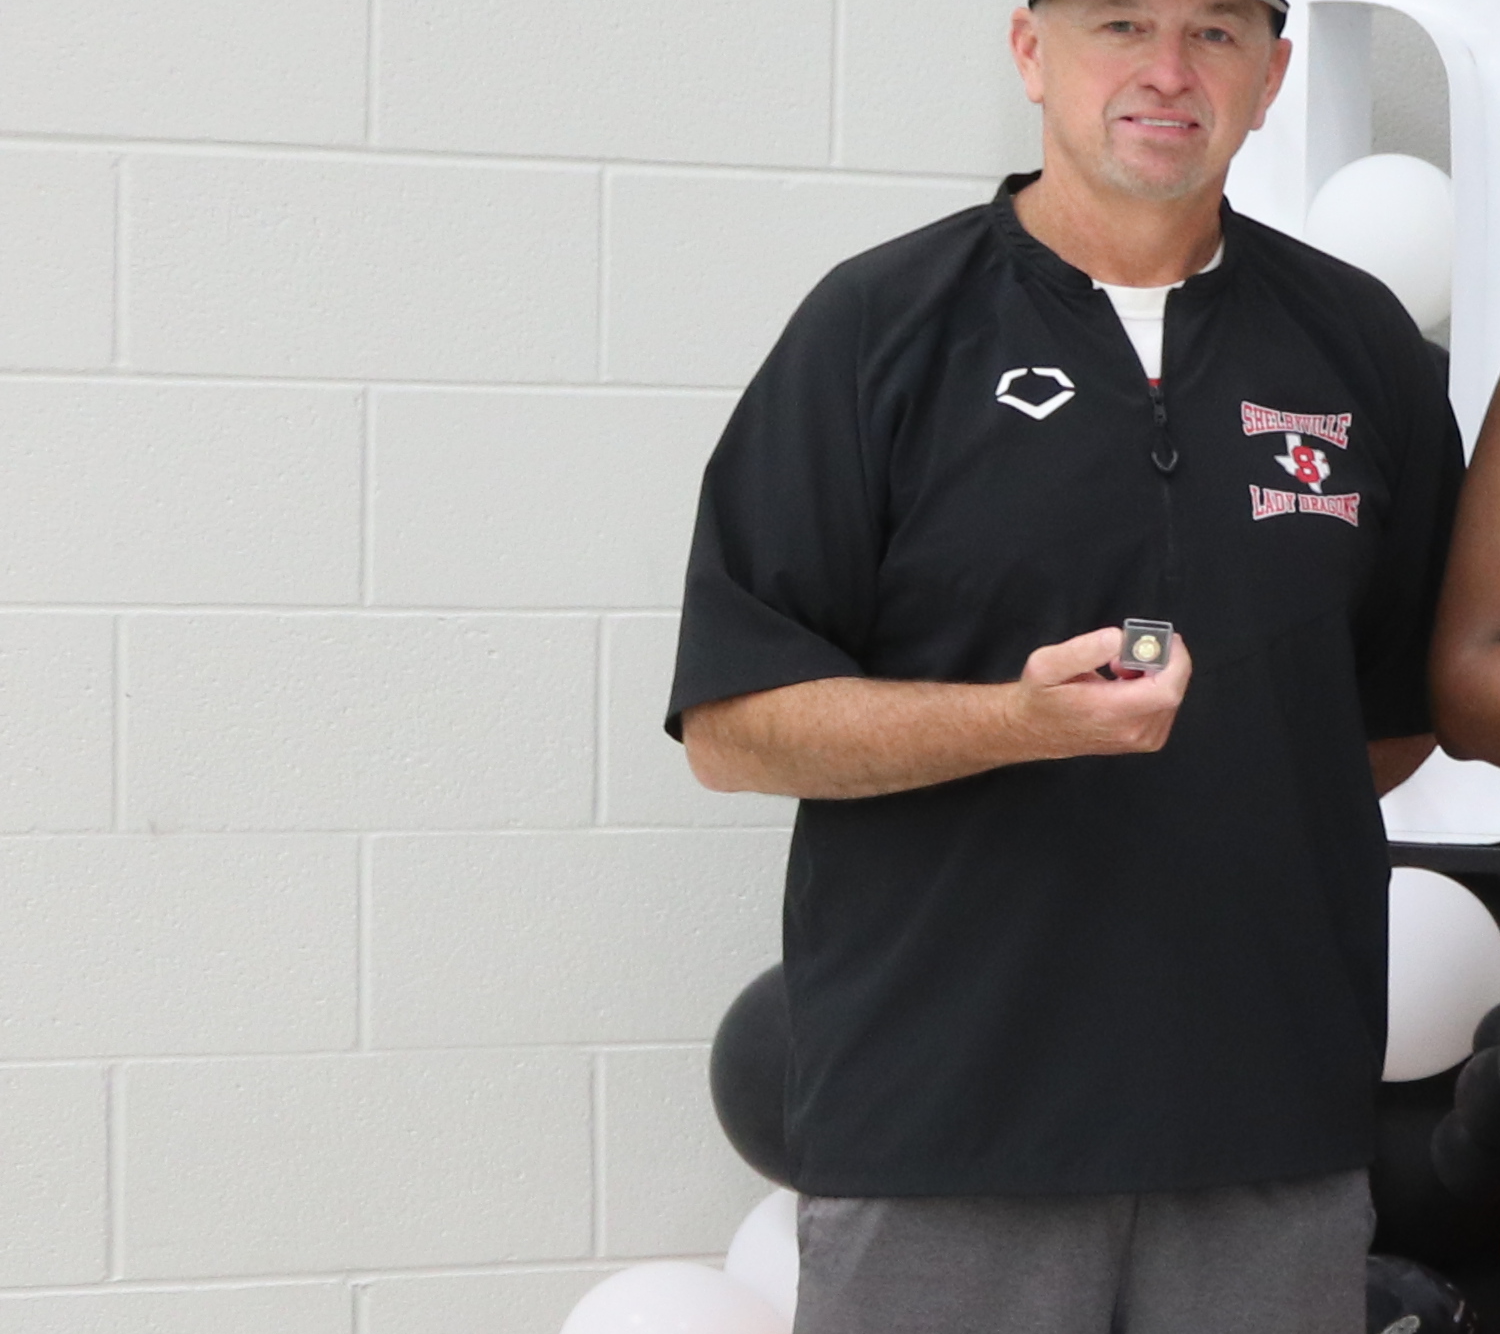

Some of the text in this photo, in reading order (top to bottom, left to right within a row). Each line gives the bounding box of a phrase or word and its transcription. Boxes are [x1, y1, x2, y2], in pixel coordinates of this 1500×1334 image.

[1241, 400, 1352, 450] SHELBYVILLE
[1248, 484, 1360, 528] LADY DRAGONS
